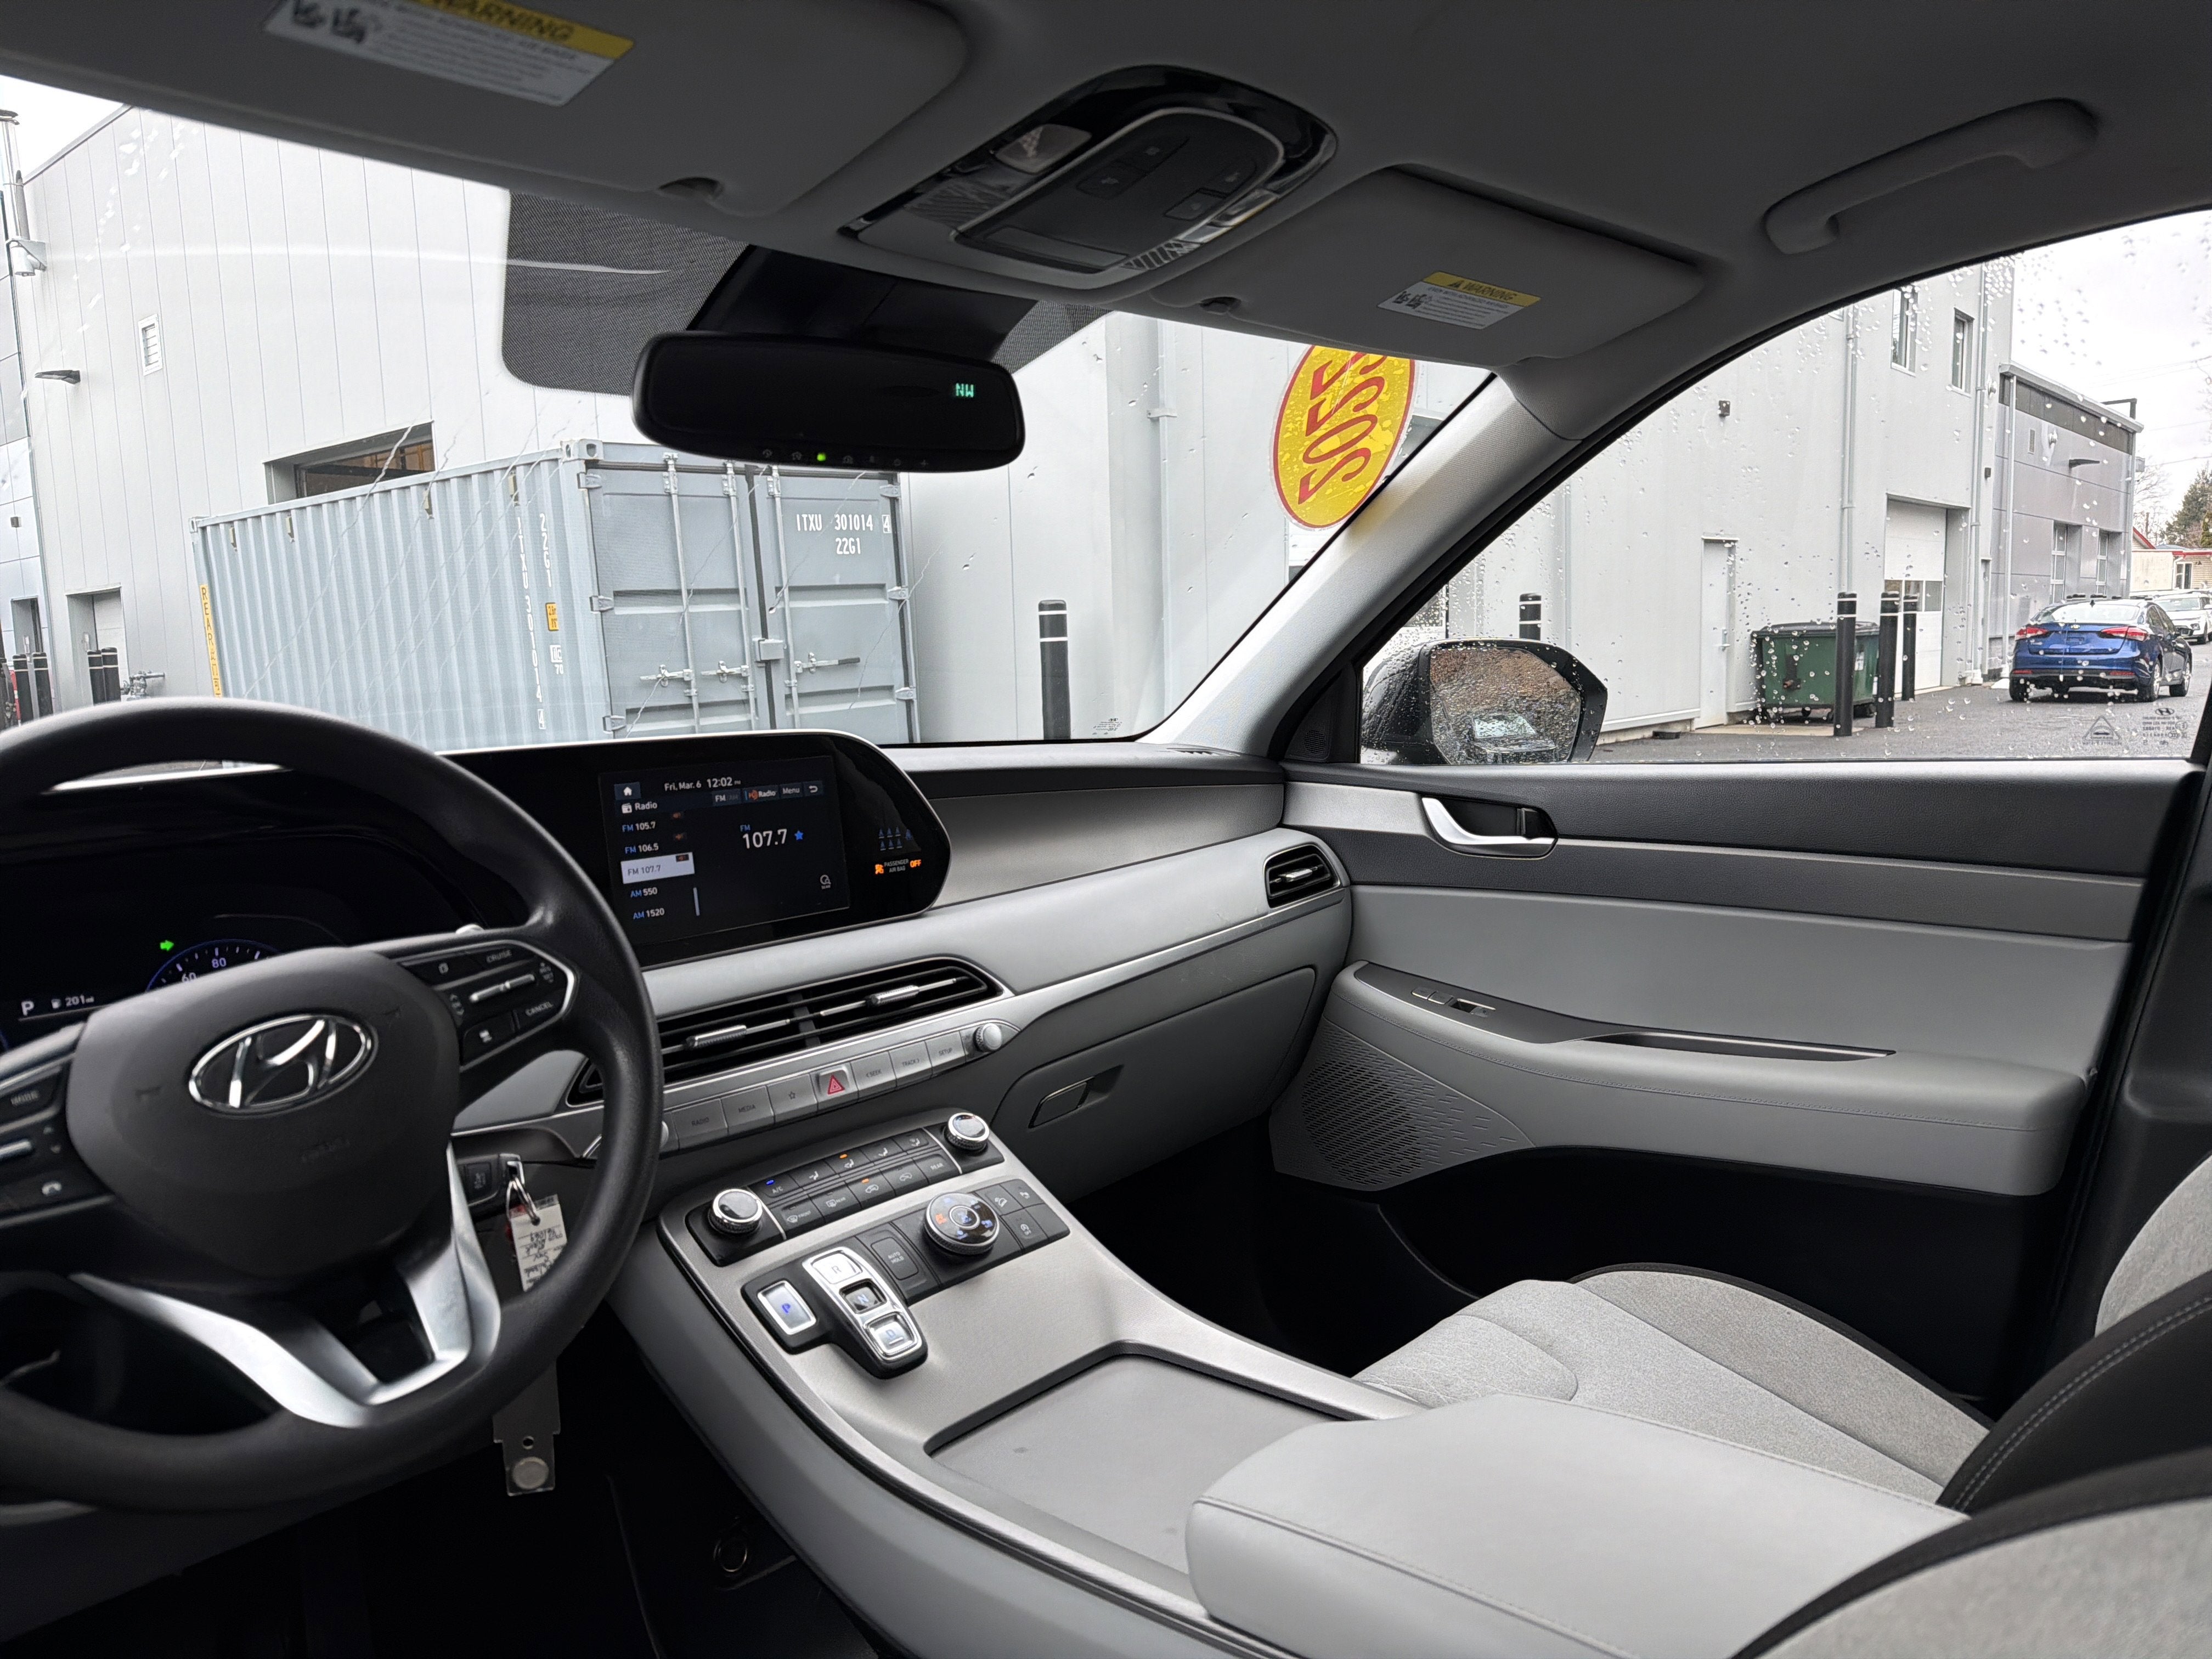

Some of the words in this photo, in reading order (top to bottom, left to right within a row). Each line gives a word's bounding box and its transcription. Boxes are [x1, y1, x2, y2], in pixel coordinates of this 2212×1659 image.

[956, 382, 975, 398] NW
[796, 514, 822, 531] ITXU
[834, 514, 873, 531] 301014
[883, 515, 891, 533] 4
[540, 514, 552, 588] 22G1
[836, 537, 861, 555] 22G1
[518, 517, 529, 589] ITXU
[526, 595, 542, 703] 301014
[201, 587, 214, 646] REAR
[554, 664, 564, 675] 70
[696, 780, 702, 788] 6
[706, 777, 733, 789] 12:02
[759, 790, 776, 798] Radio
[635, 801, 658, 810] Radio
[636, 821, 656, 831] 105.7
[742, 828, 787, 849] 107.7
[625, 846, 636, 854] FM
[638, 843, 659, 853] 106.5
[884, 859, 909, 867] PASSENGER
[910, 859, 922, 868] OFF
[641, 865, 661, 874] 107.7
[630, 890, 642, 898] AM
[643, 887, 658, 896] 550
[633, 911, 645, 920] AM
[646, 908, 665, 918] 1520
[211, 957, 227, 969] 80
[21, 1001, 34, 1015] P
[525, 1001, 553, 1016] CANCEL
[738, 1104, 756, 1113] MEDIA
[691, 1117, 709, 1126] RADIO
[772, 1185, 783, 1194] A/C
[831, 1265, 842, 1274] R
[857, 1294, 869, 1304] N
[782, 1304, 791, 1314] P
